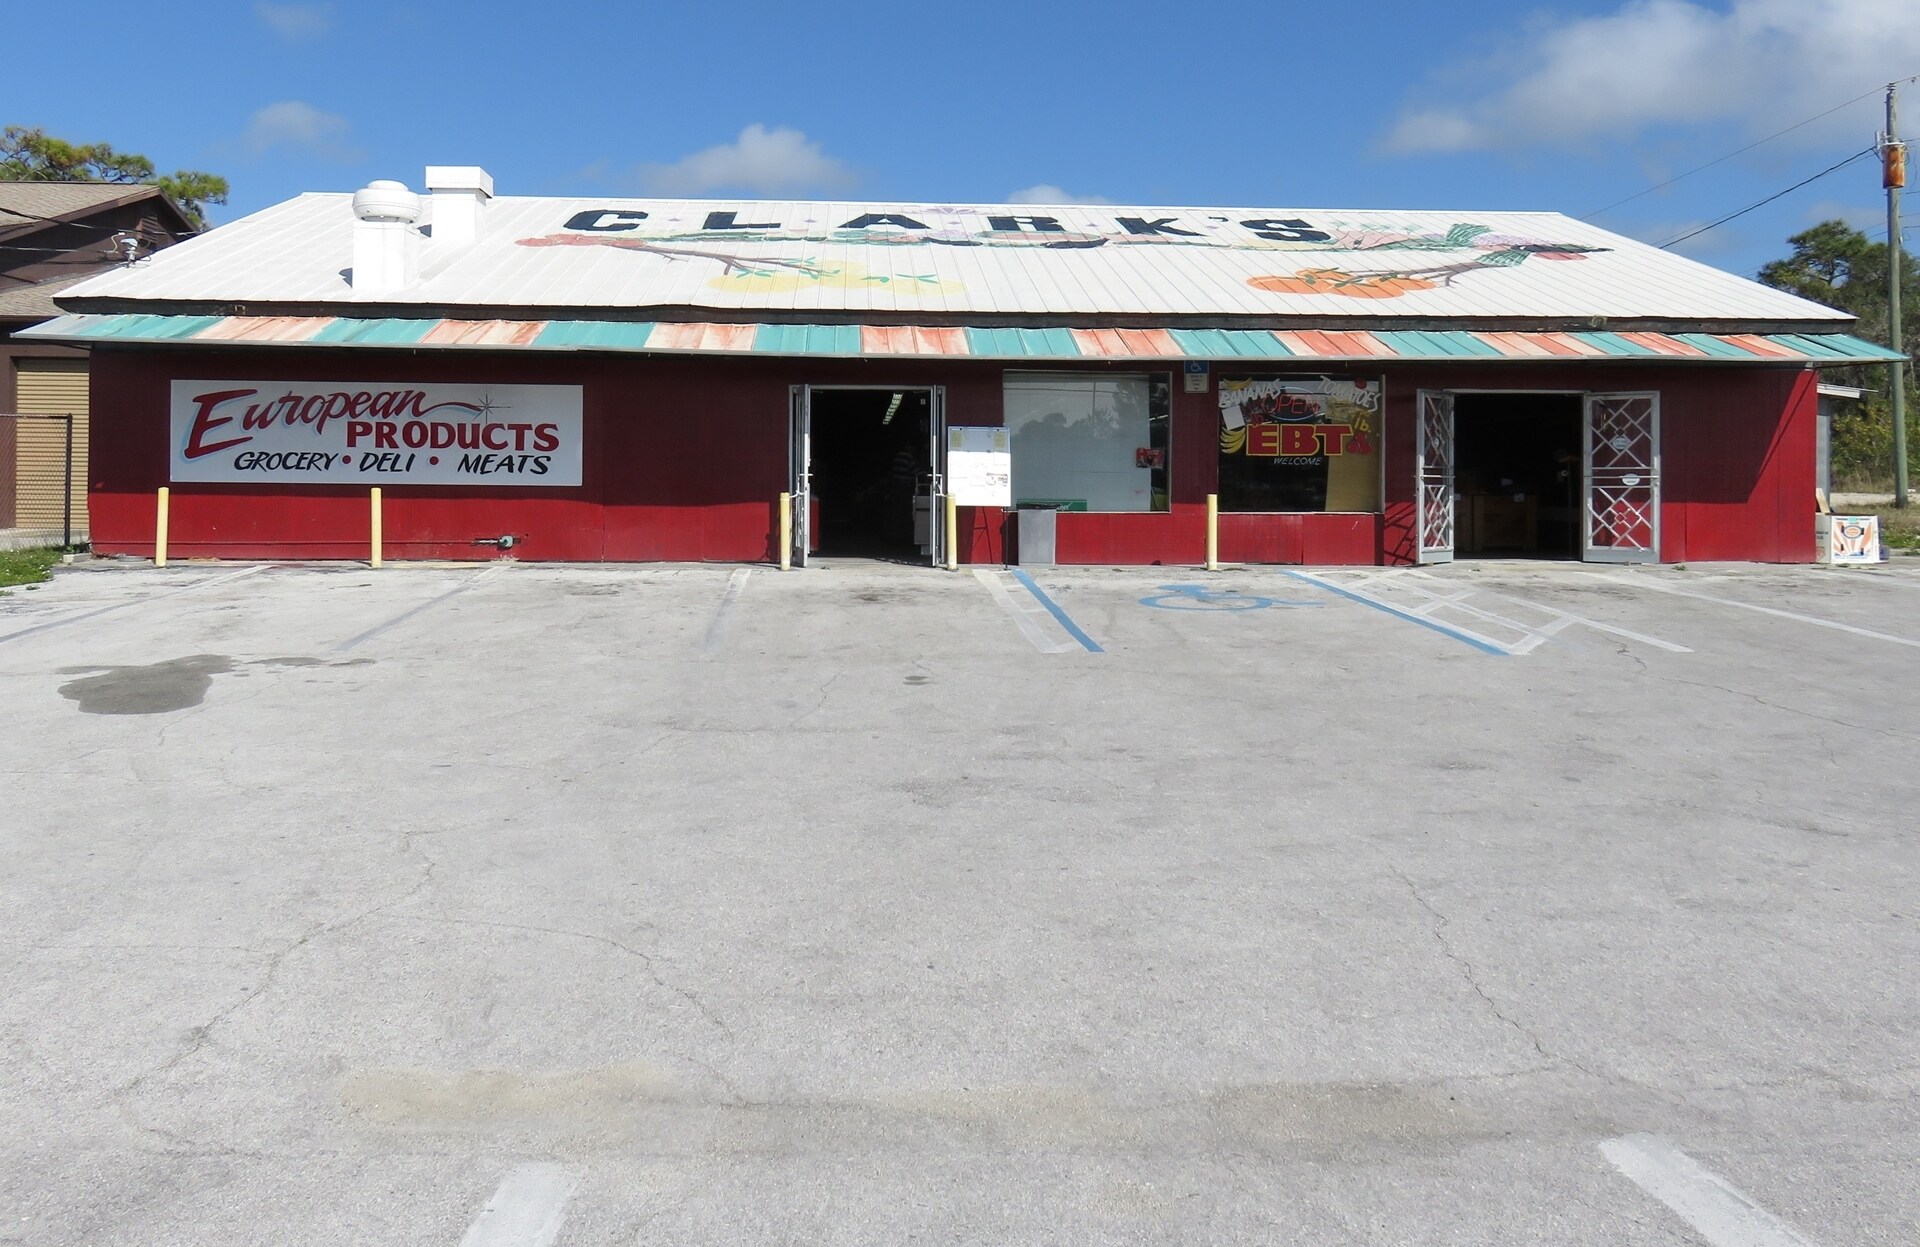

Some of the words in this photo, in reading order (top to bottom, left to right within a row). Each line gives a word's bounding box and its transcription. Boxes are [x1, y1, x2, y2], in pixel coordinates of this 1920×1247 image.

[563, 209, 1332, 242] CLARK'S
[1218, 378, 1282, 408] BANANAS
[1262, 393, 1320, 415] OPEN
[1318, 375, 1382, 412] TOMATOES
[185, 389, 440, 457] European
[346, 420, 560, 452] PRODUCTS
[1246, 423, 1354, 456] EBT
[234, 451, 338, 472] GROCERY
[359, 452, 416, 473] DELI
[457, 453, 552, 475] MEATS
[1273, 457, 1323, 466] WELCOME
